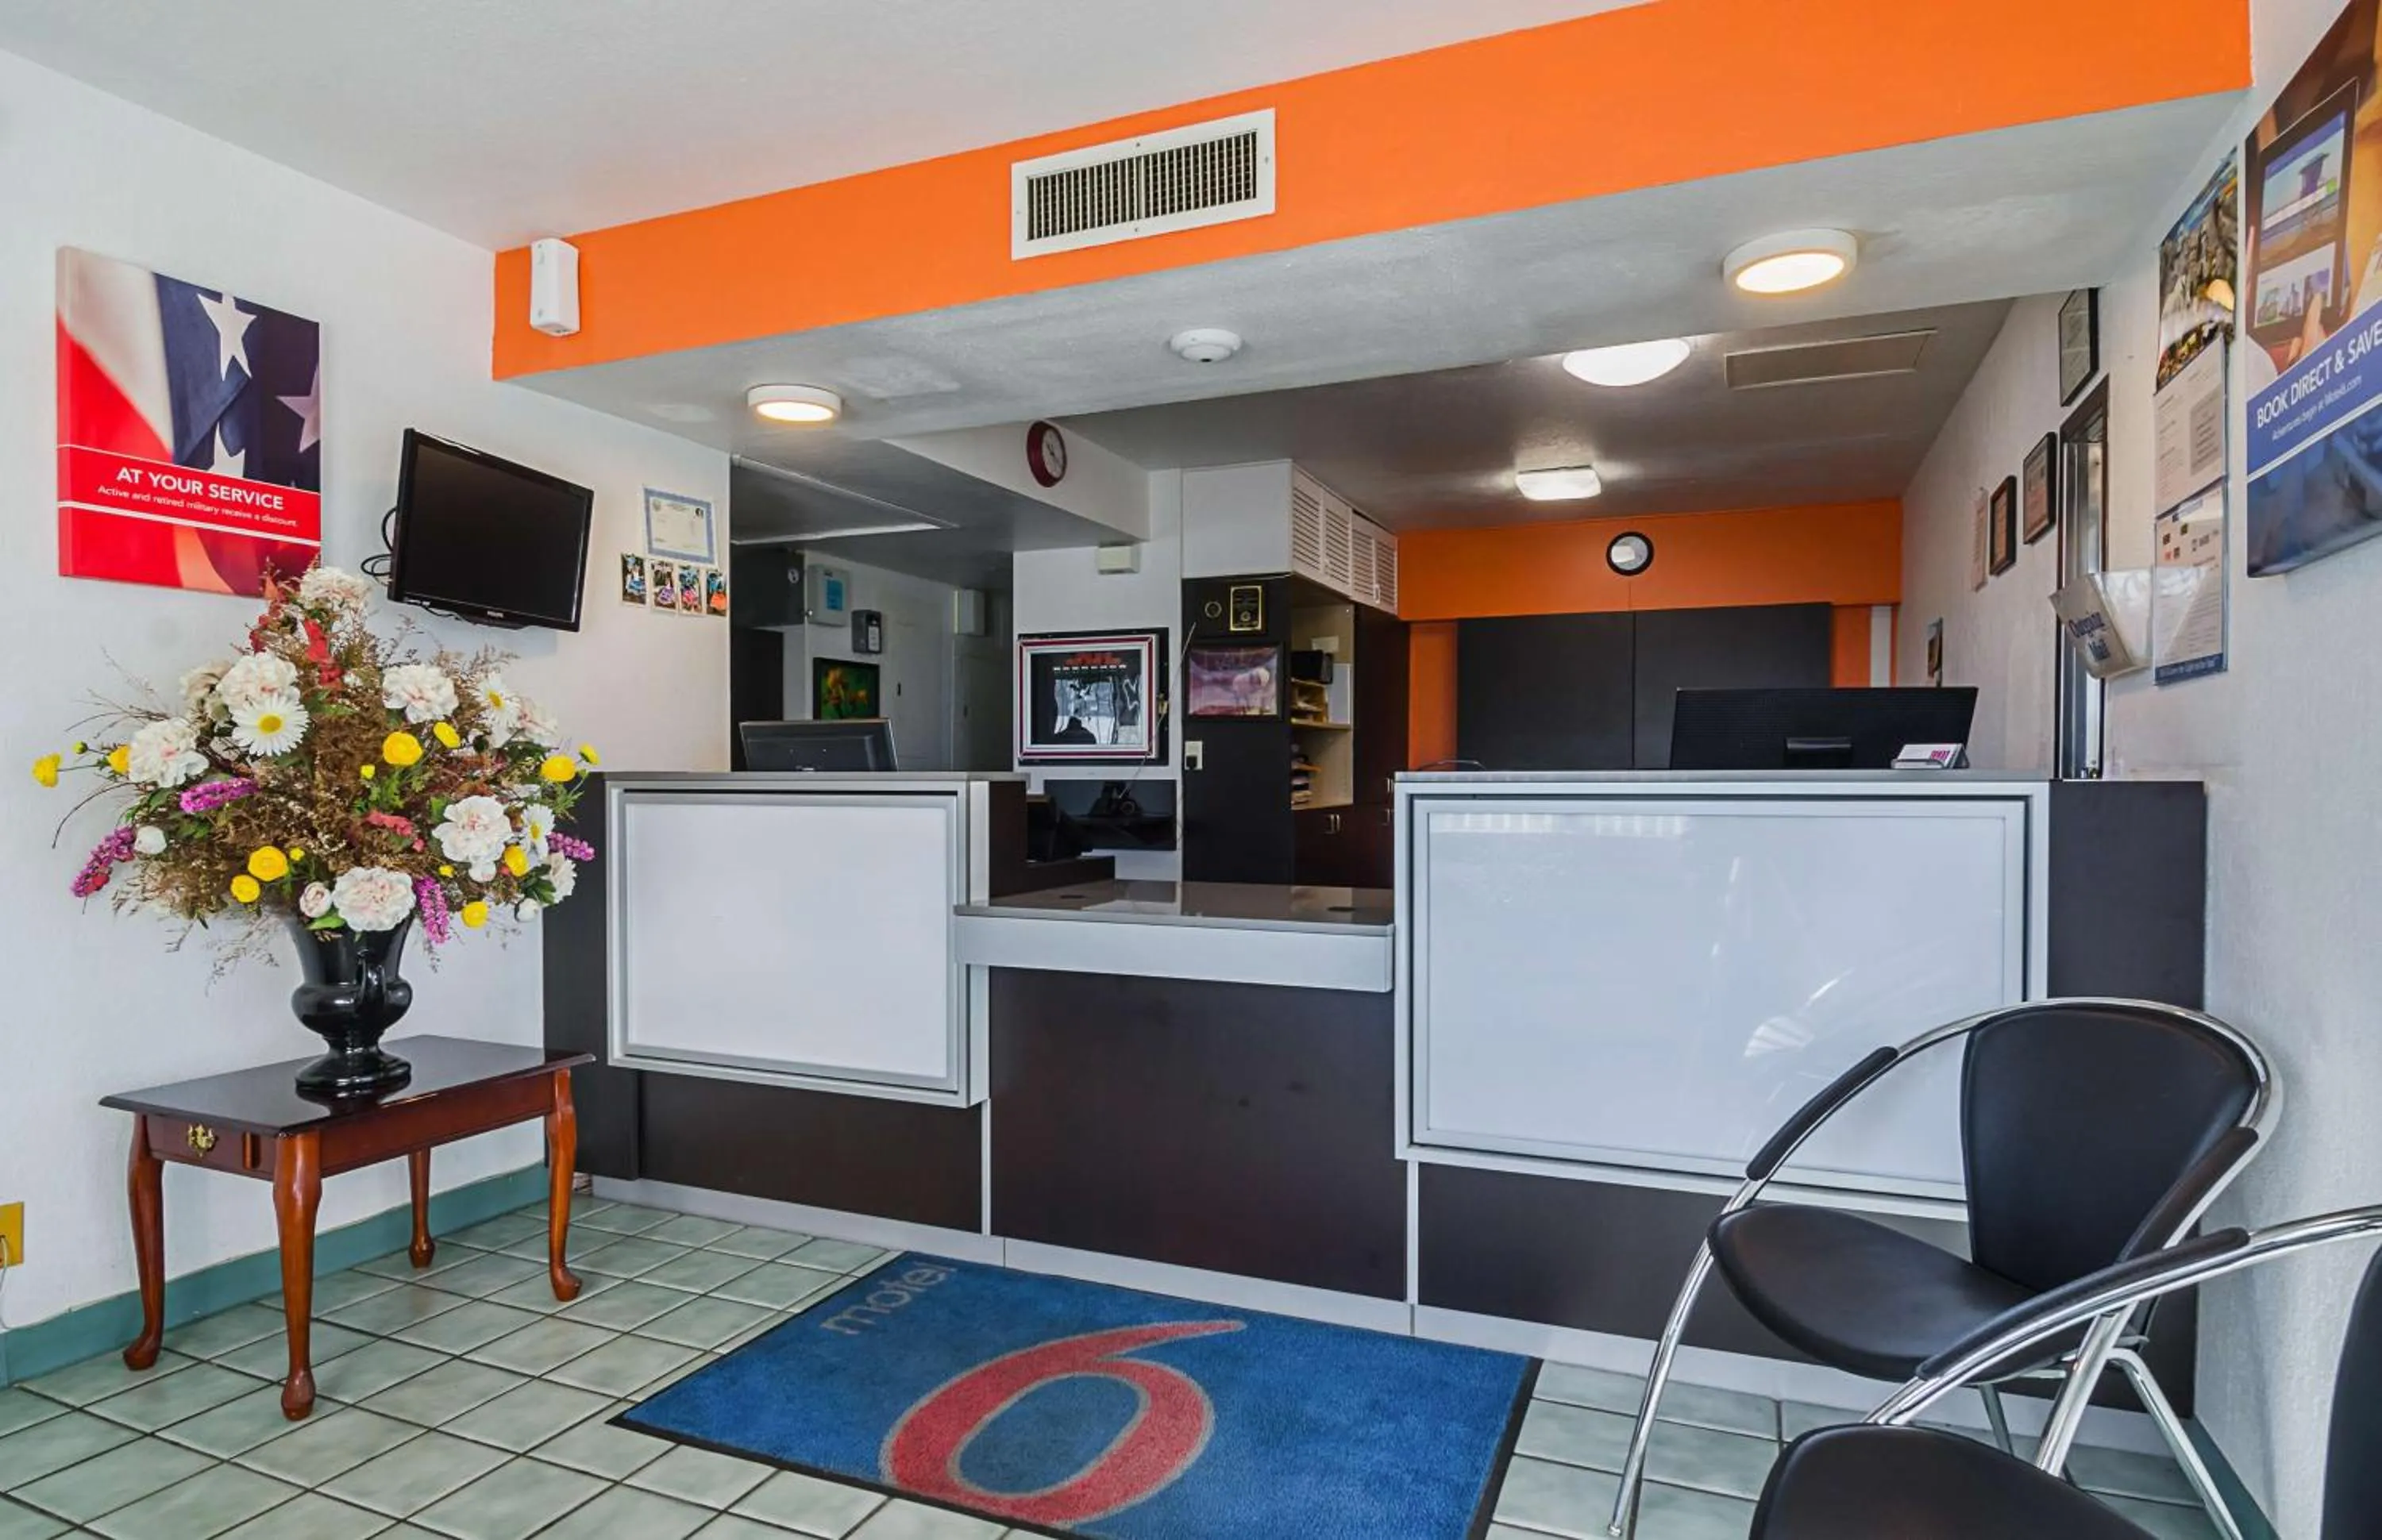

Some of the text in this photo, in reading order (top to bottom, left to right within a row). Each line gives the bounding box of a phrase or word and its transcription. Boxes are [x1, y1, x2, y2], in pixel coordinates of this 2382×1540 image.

[2257, 319, 2382, 429] BOOK DIRECT & SAVE
[98, 485, 130, 499] Active
[132, 490, 151, 502] and
[153, 495, 185, 508] retired
[186, 500, 220, 515] military
[222, 506, 252, 520] receive
[253, 512, 260, 522] a
[117, 466, 285, 510] AT YOUR SERVICE
[820, 1261, 958, 1335] motel
[877, 1319, 1247, 1529] 6
